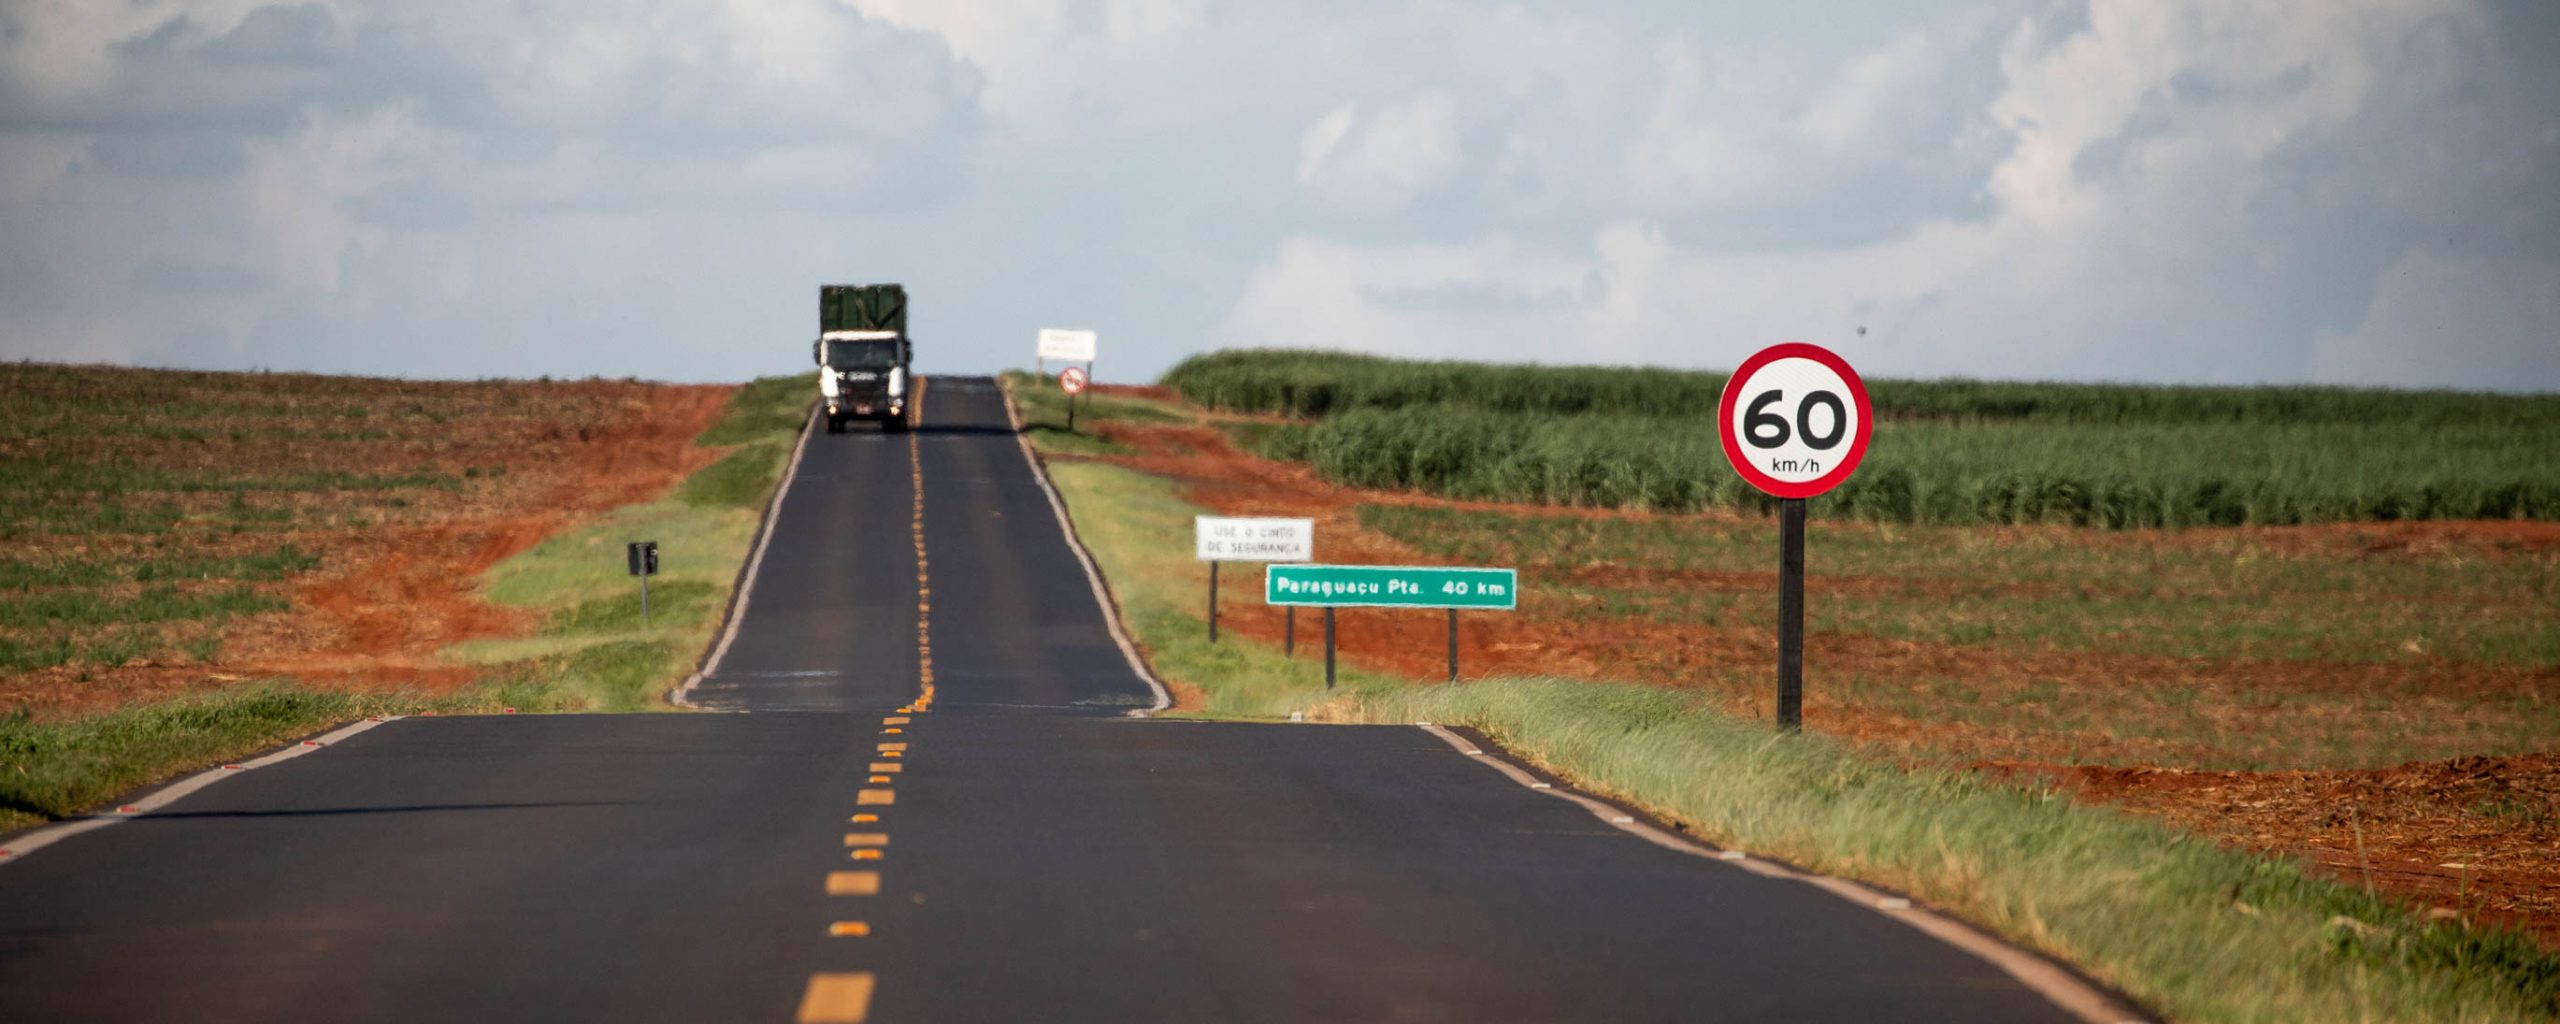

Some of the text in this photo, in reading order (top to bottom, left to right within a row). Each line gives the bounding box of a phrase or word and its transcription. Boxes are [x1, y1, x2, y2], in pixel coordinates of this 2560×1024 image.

[1743, 389, 1847, 450] 60
[1772, 458, 1820, 473] km/h
[1207, 540, 1222, 552] DE
[1277, 576, 1506, 598] Paraguaçu Pta. 40 km
